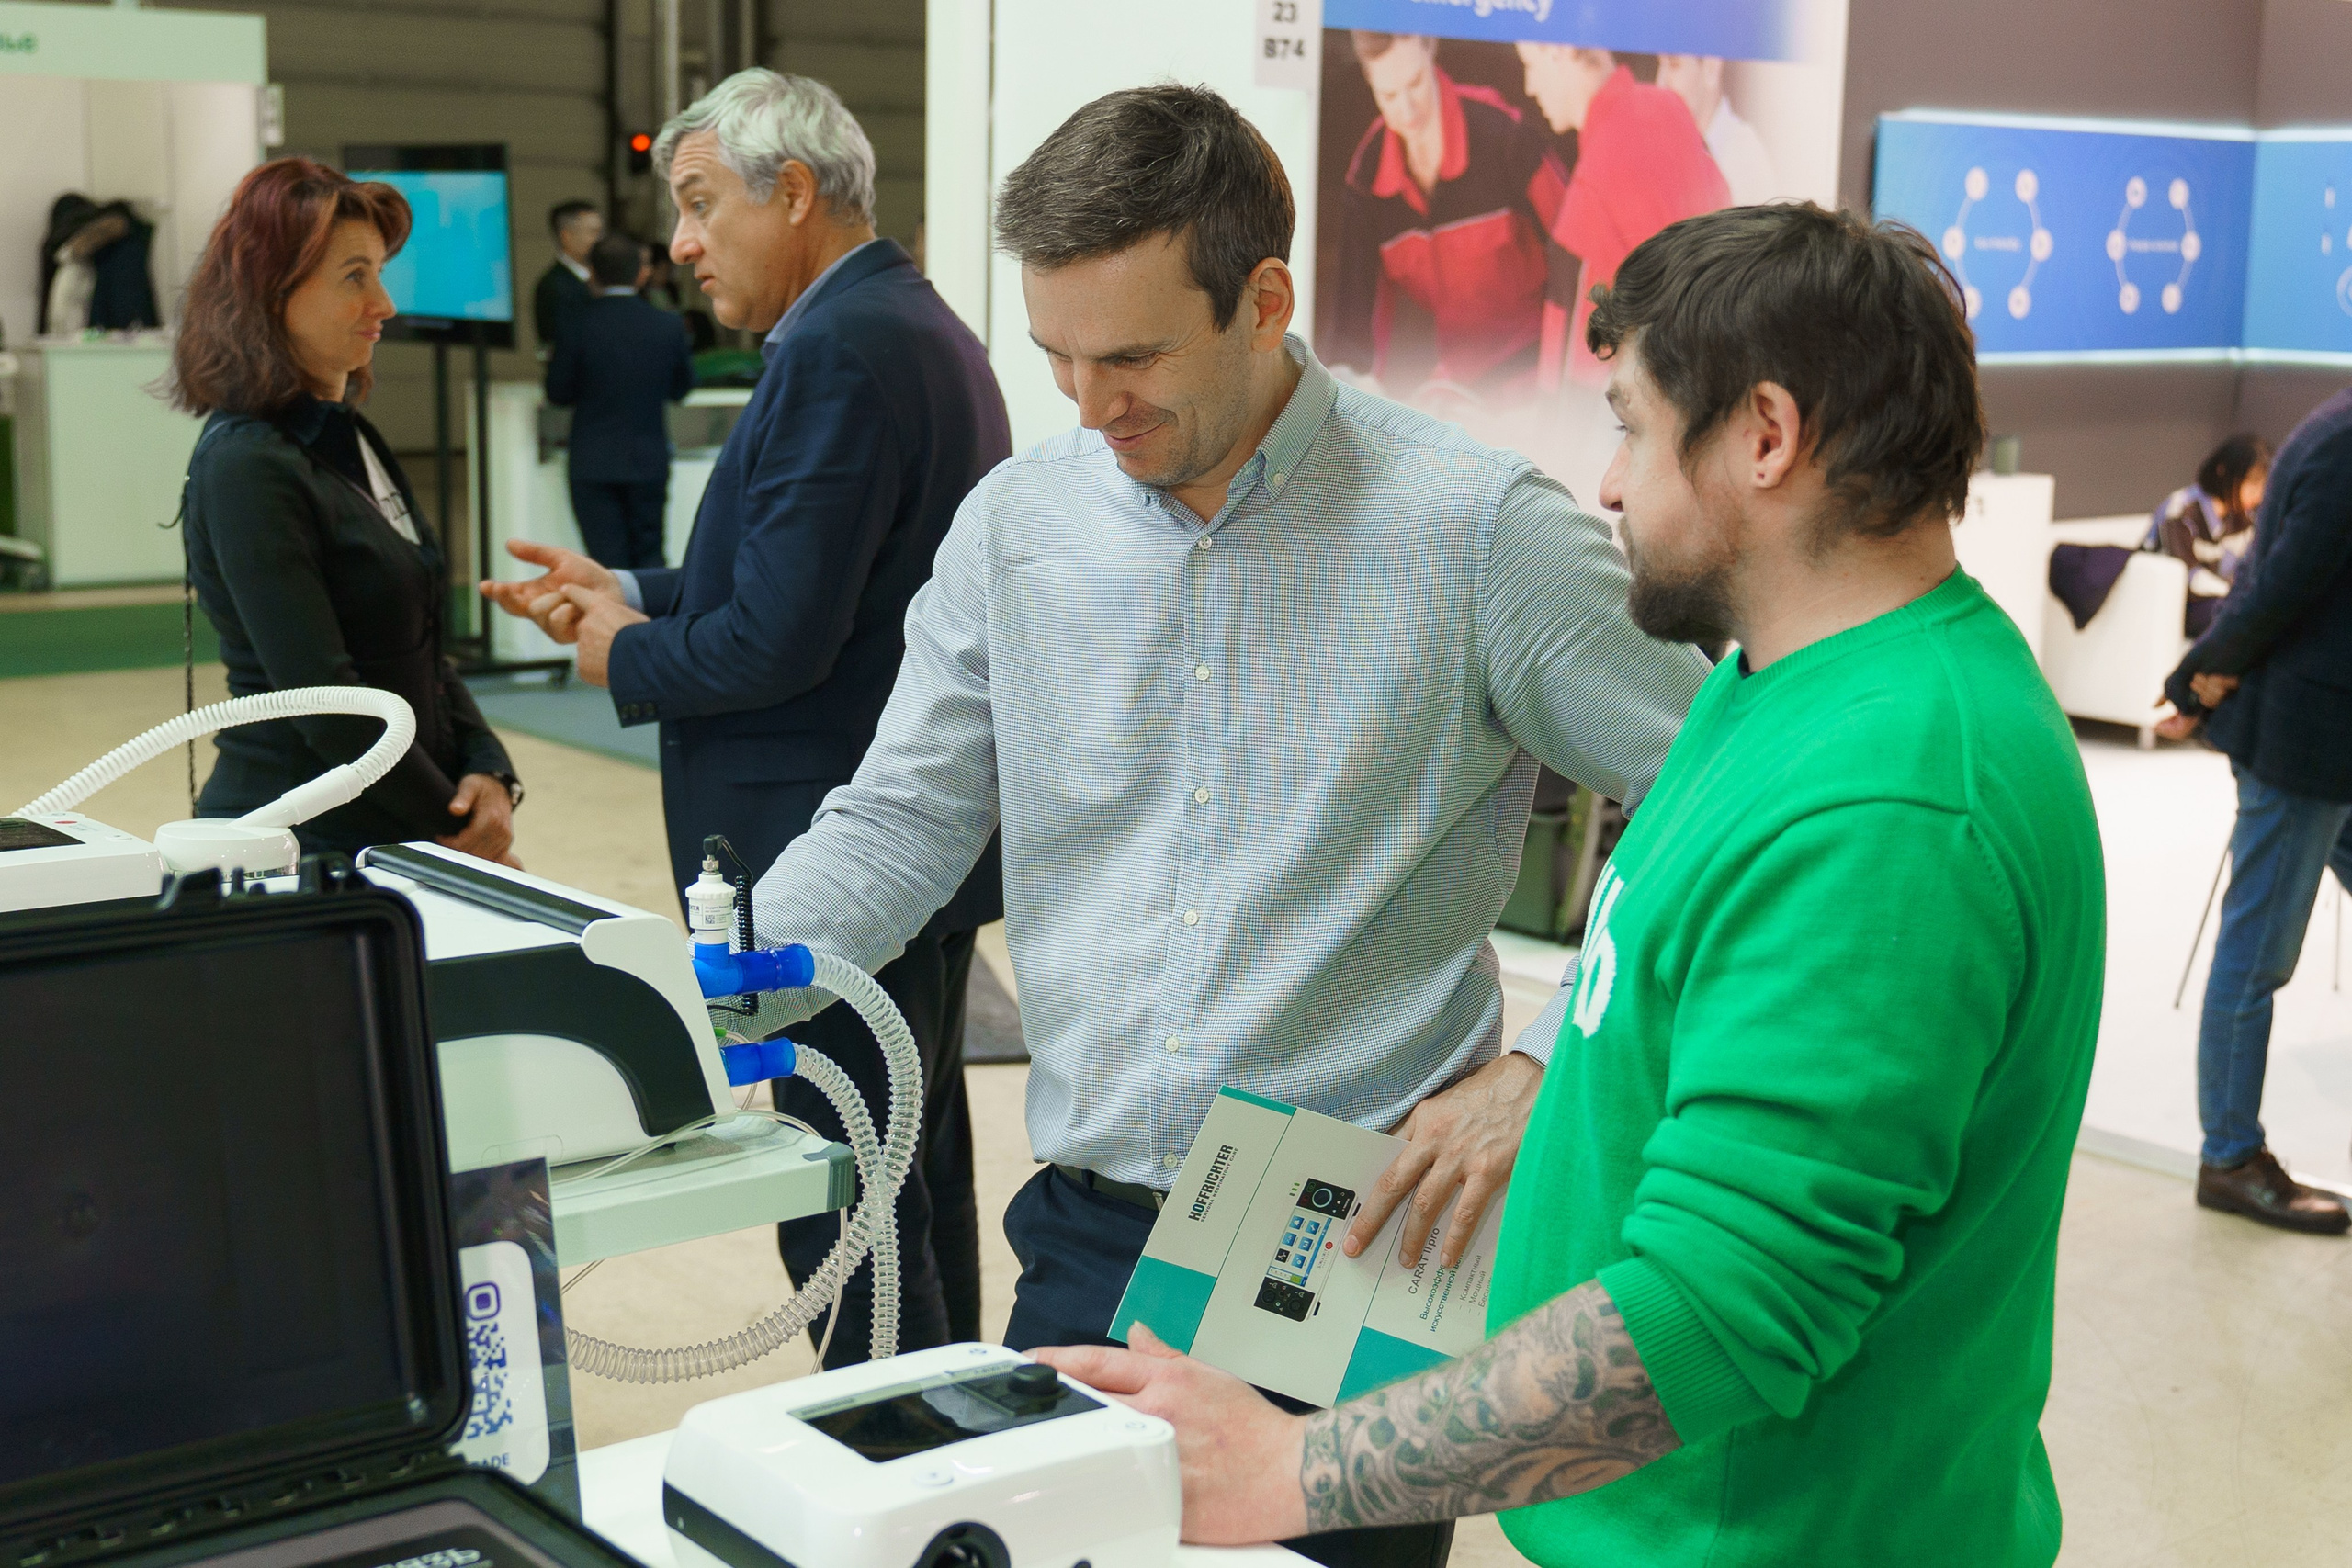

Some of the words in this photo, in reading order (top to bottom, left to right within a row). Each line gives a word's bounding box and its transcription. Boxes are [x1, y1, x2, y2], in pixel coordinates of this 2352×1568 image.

[1188, 1145, 1233, 1221] HOFFRICHTER
[1408, 1254, 1428, 1294] CARAT
[1428, 1227, 1440, 1248] pro
[1460, 1254, 1482, 1302] Компактный
[1468, 1270, 1487, 1304] Мощный
[1419, 1264, 1446, 1321] Высокоэффе
[1430, 1270, 1457, 1333] искусственной
